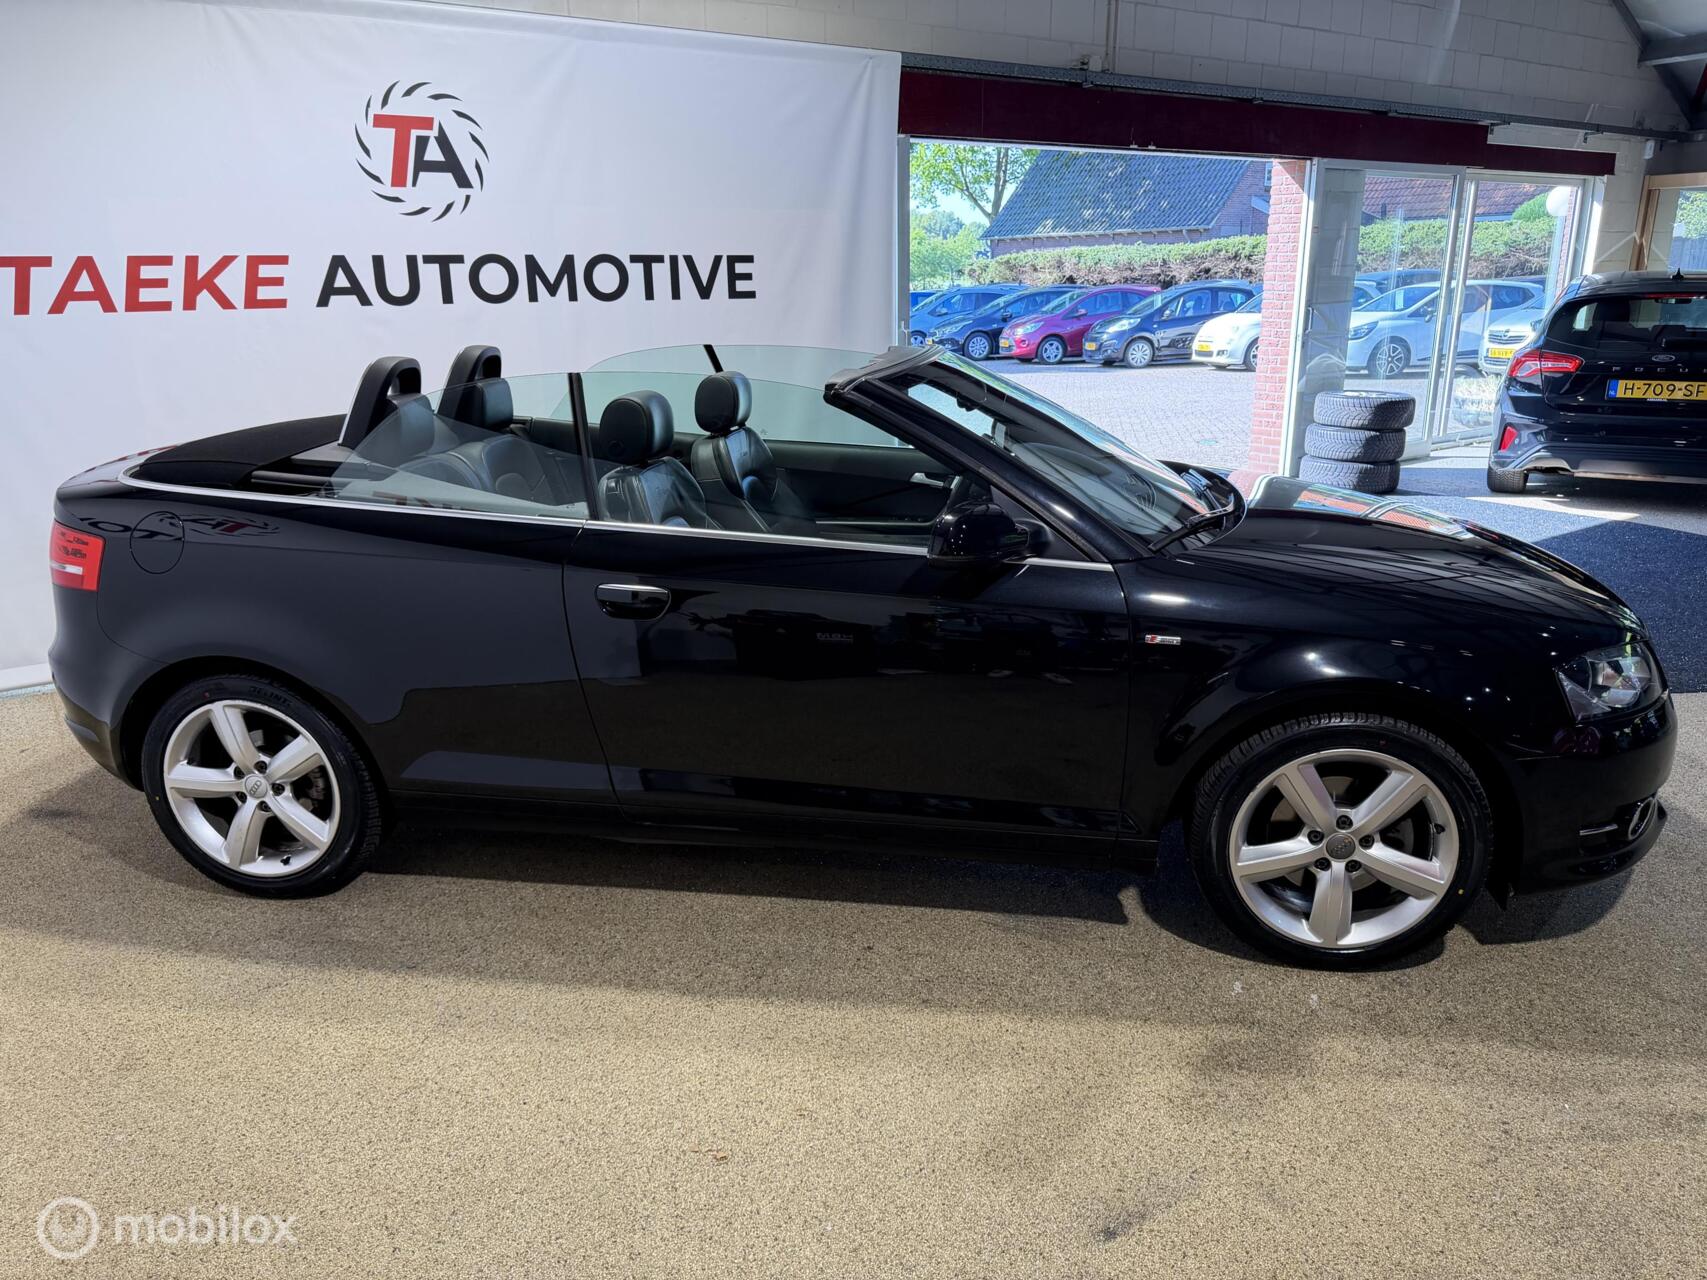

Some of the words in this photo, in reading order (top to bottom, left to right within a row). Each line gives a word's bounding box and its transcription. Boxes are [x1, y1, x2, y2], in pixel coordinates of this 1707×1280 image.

[373, 113, 474, 189] TA
[0, 255, 289, 316] TAEKE
[316, 253, 757, 308] AUTOMOTIVE
[1623, 382, 1707, 398] H-709-SF
